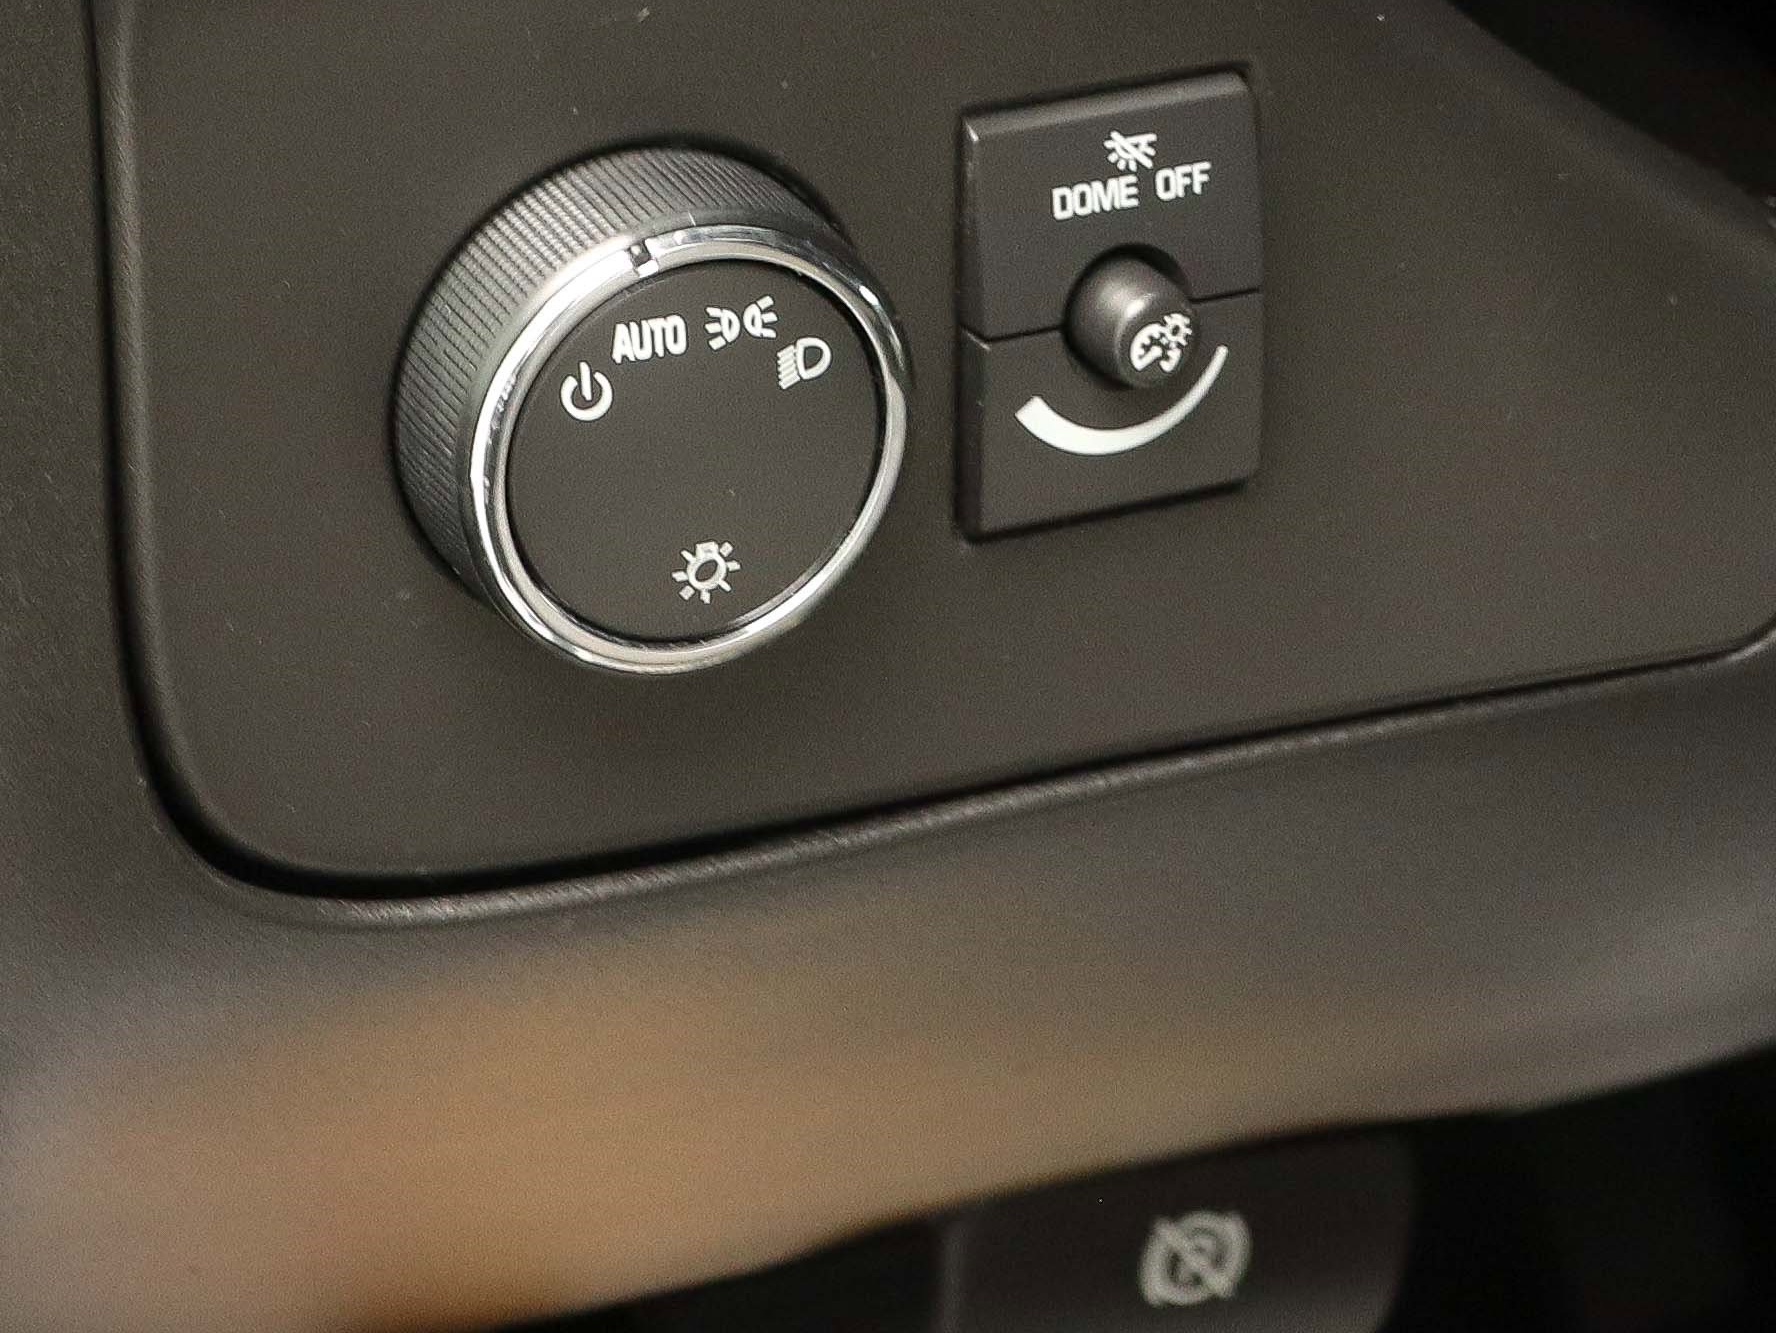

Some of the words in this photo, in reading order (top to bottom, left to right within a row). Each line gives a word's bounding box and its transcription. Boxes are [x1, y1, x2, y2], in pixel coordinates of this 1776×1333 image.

[1052, 173, 1140, 221] DOME
[1155, 154, 1212, 201] OFF
[611, 314, 687, 365] AUTO
